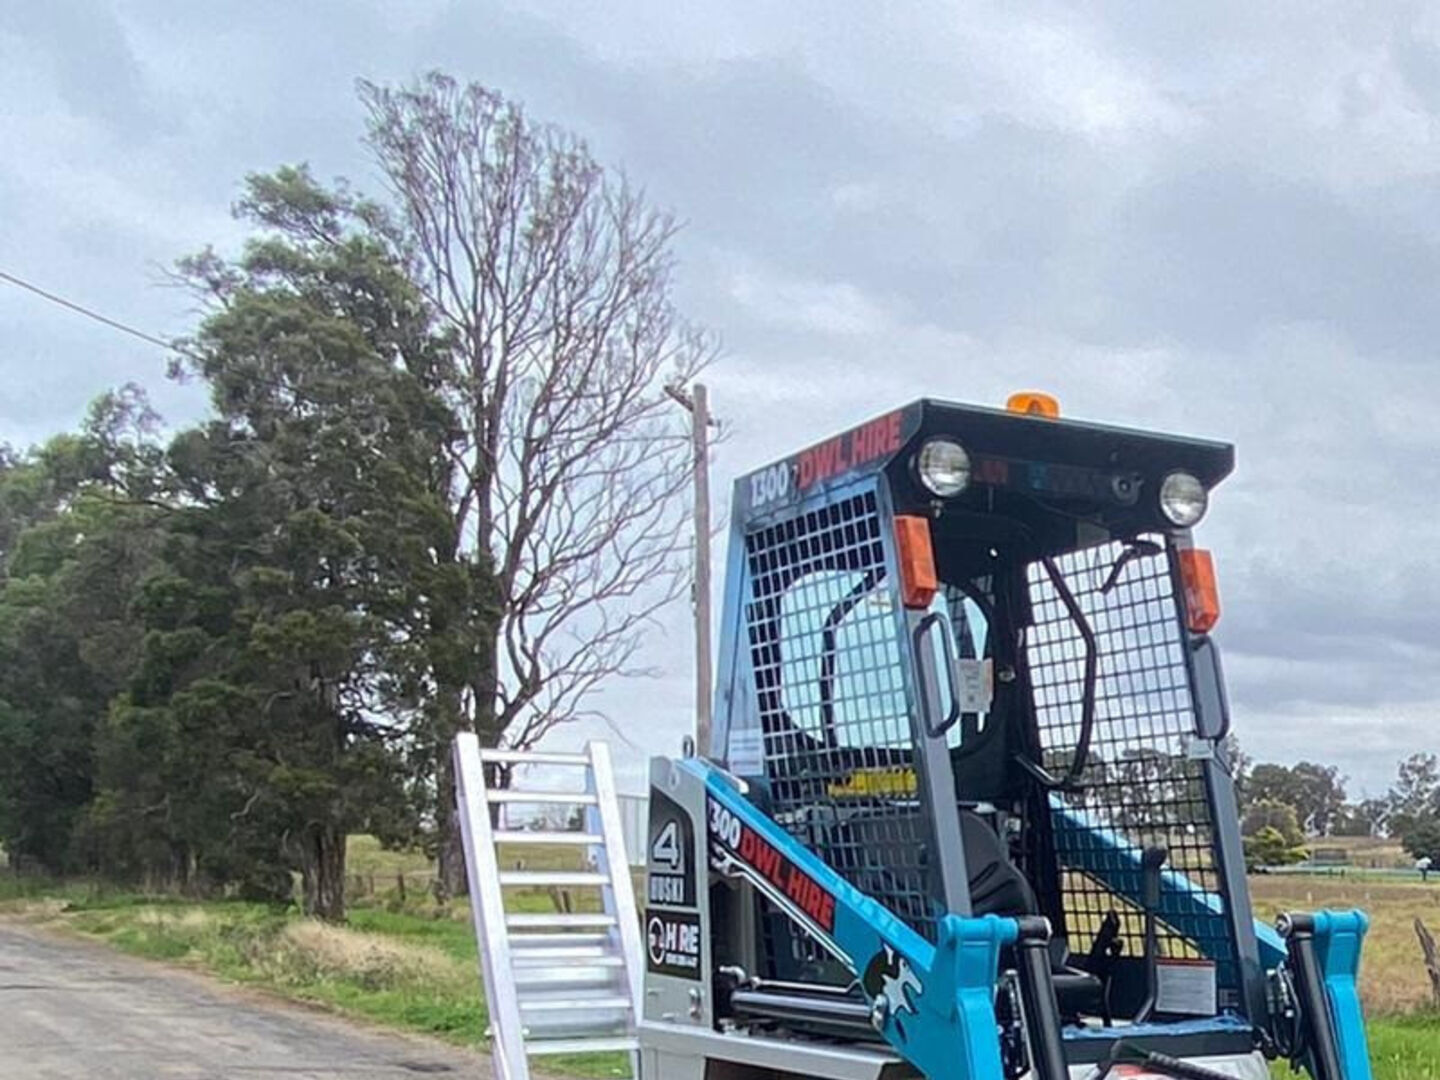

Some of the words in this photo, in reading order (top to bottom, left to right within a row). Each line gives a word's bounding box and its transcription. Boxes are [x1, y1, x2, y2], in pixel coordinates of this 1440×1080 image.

[751, 462, 789, 507] 1300
[800, 437, 847, 490] DWL
[852, 411, 903, 466] HIRE
[653, 822, 679, 867] 4
[741, 827, 784, 888] DWL
[787, 879, 835, 932] HIRE
